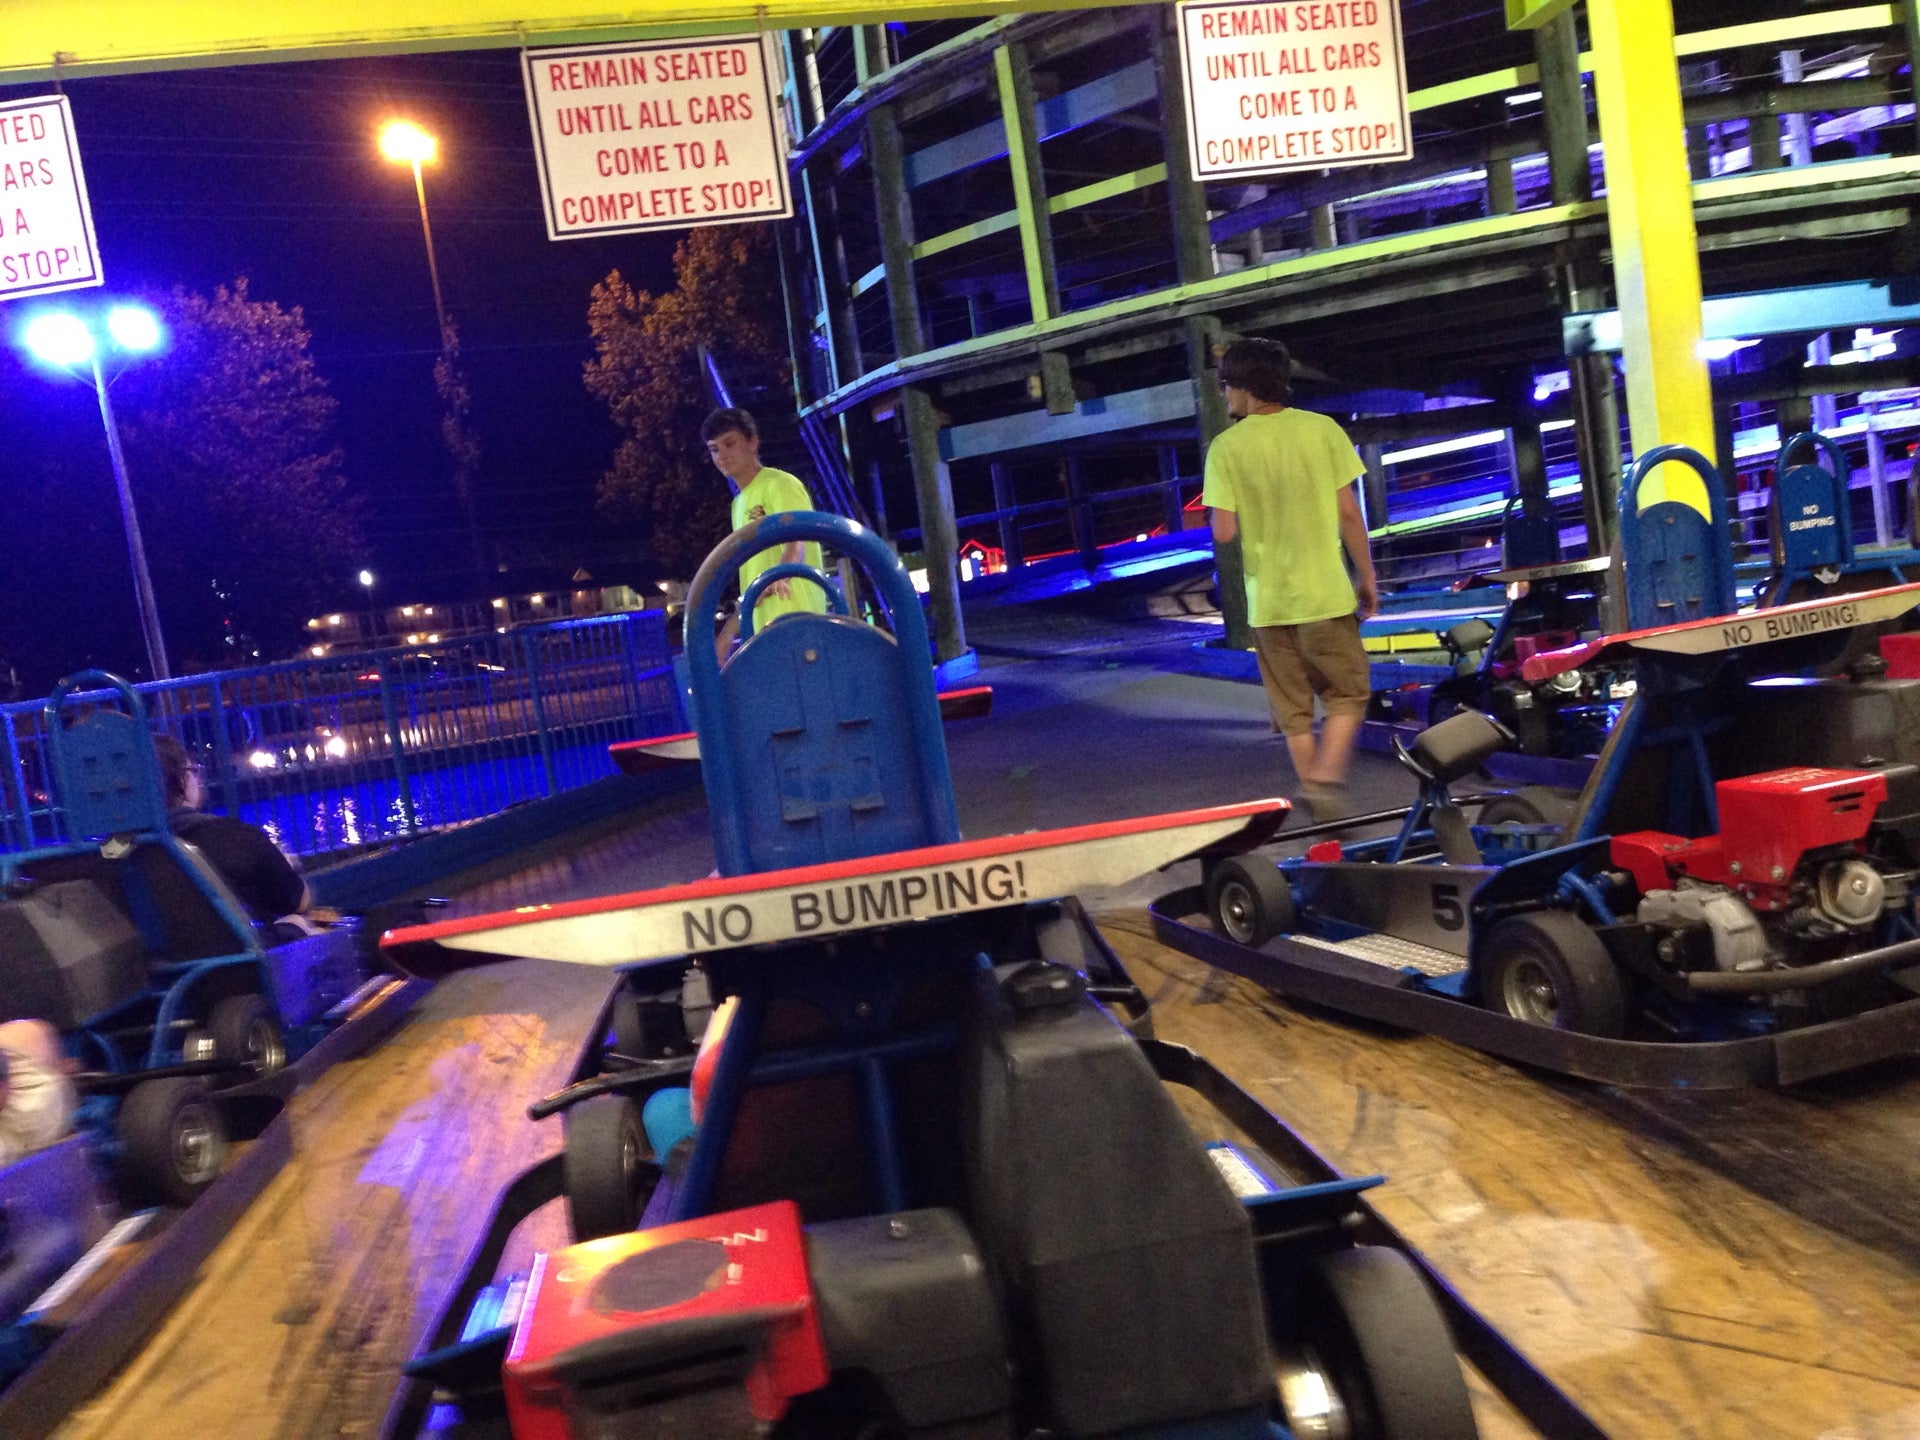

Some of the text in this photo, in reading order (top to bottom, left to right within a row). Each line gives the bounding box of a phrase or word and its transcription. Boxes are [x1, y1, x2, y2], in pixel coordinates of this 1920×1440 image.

[1202, 1, 1378, 39] REMAIN SEATED
[549, 49, 748, 91] REMAIN SEATED
[1207, 42, 1381, 81] UNTIL ALL CARS
[557, 92, 753, 135] UNTIL ALL CARS
[1239, 85, 1358, 120] COME TO A
[596, 139, 730, 177] COME TO A
[1206, 122, 1396, 165] COMPLETE STOP!
[15, 208, 30, 235] A
[562, 179, 775, 225] COMPLETE STOP!
[3, 245, 82, 282] STOP!
[1789, 515, 1836, 532] BUMPING
[1803, 504, 1819, 515] NO
[1722, 603, 1860, 647] NO BUMPING!
[682, 860, 1028, 949] NO BUMPING!
[1431, 883, 1464, 931] 5
